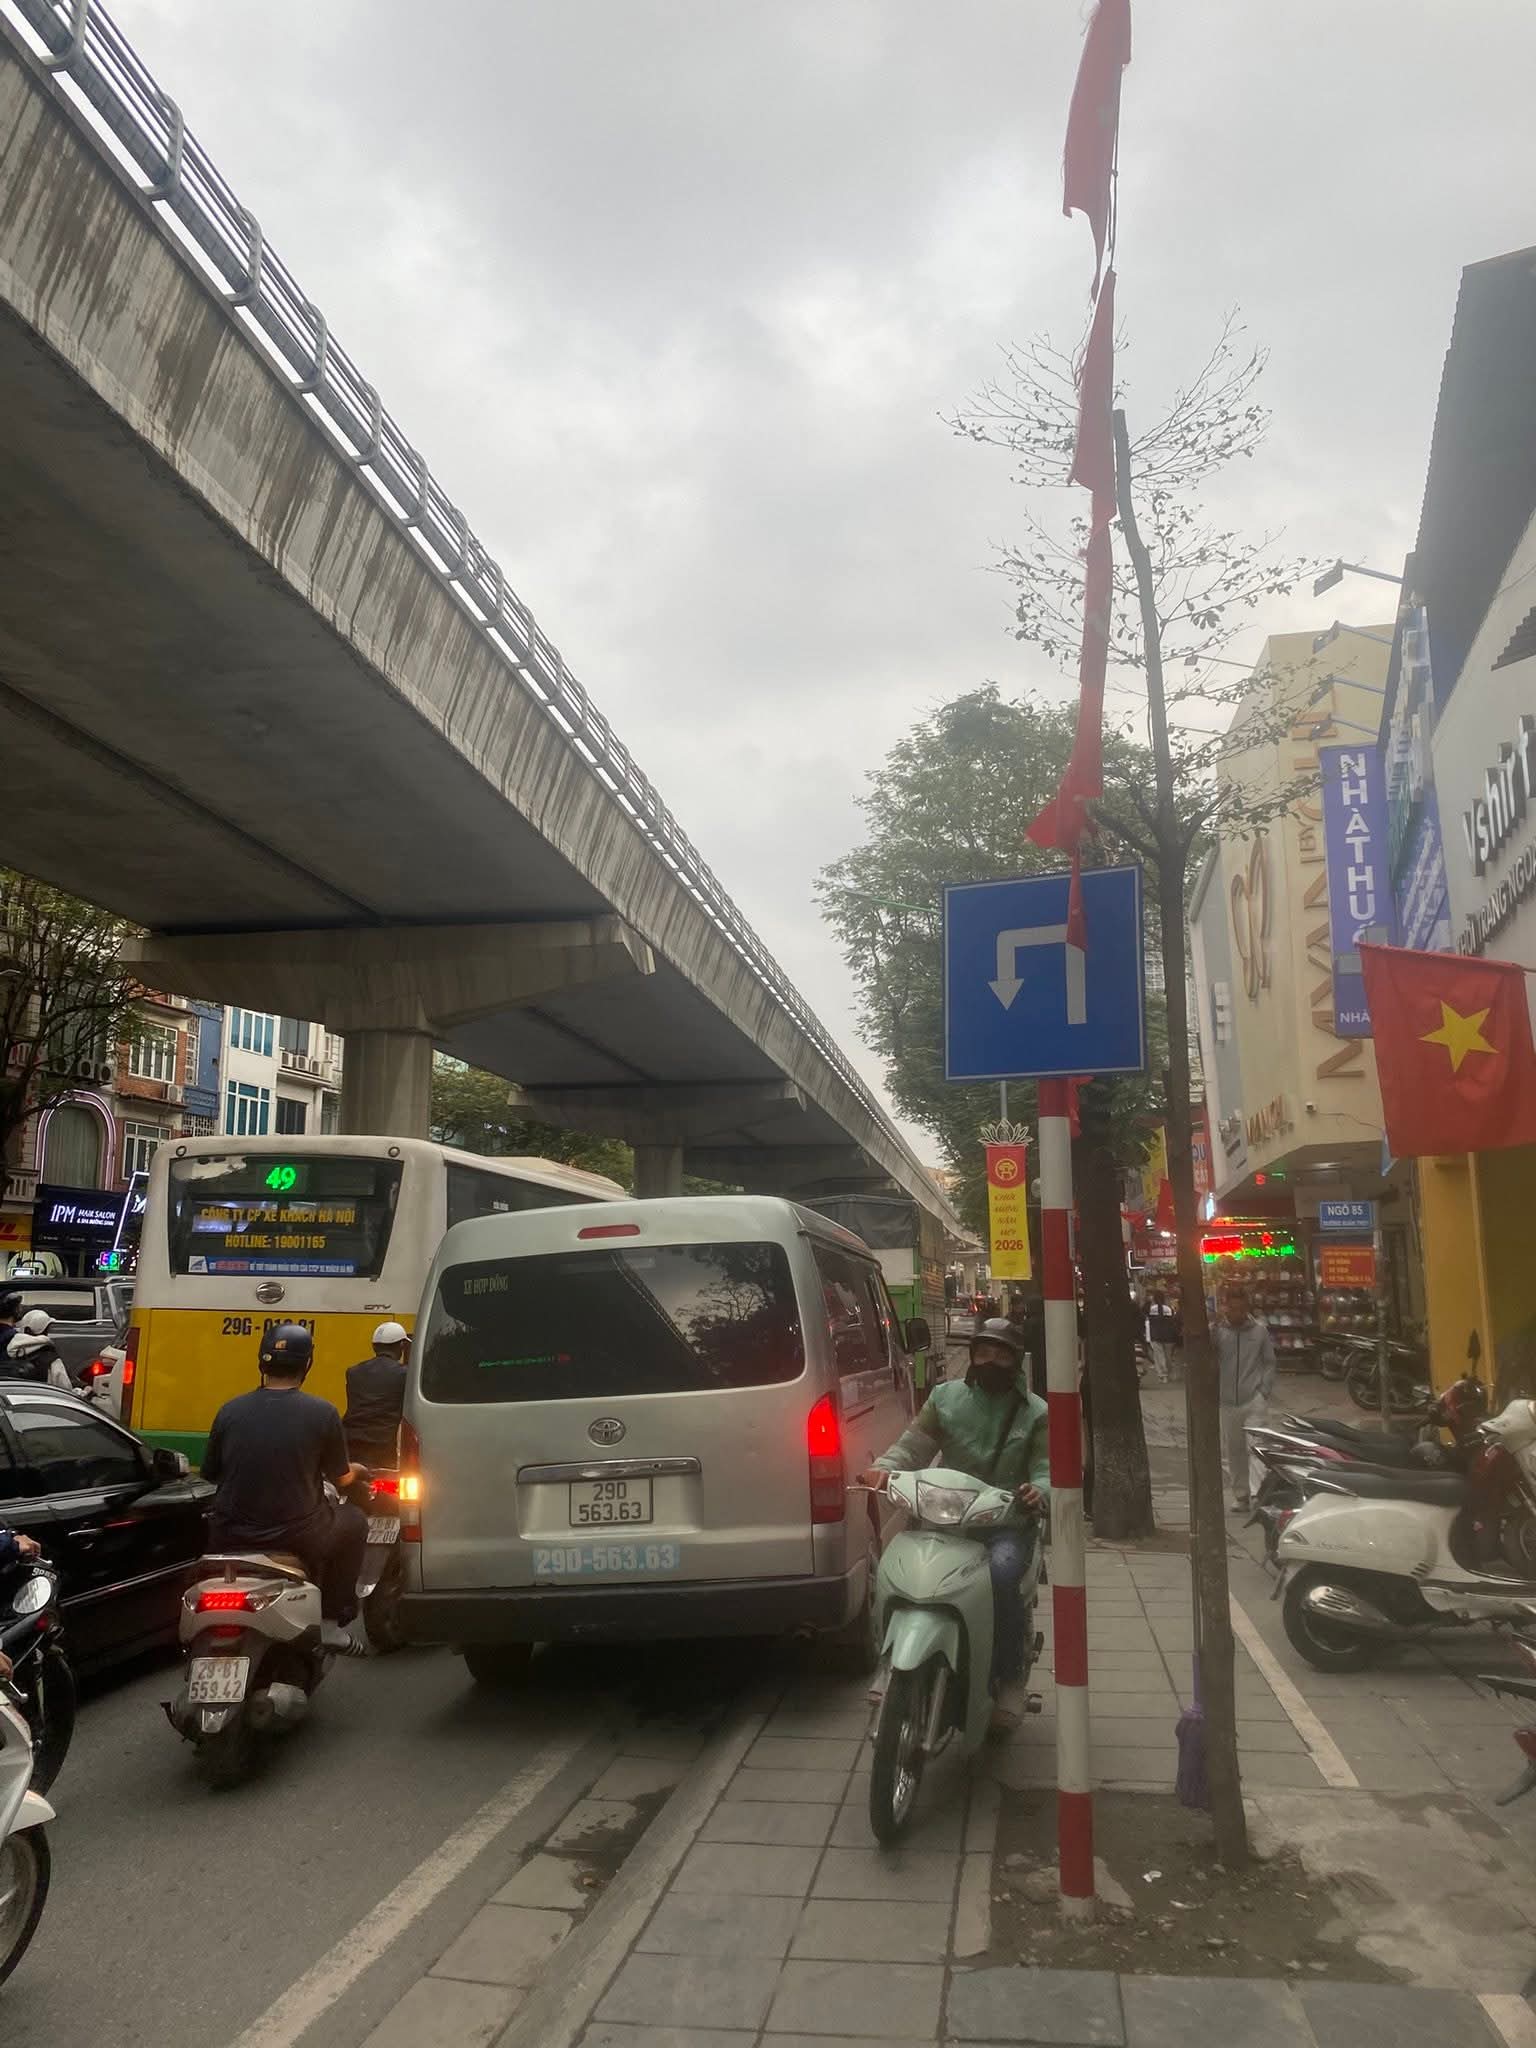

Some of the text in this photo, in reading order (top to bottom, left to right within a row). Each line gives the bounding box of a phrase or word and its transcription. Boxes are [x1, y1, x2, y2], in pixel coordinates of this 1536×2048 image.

[265, 1166, 297, 1190] 49
[95, 1210, 116, 1220] SALON
[201, 1207, 229, 1222] CÔNG
[233, 1208, 244, 1222] TY
[247, 1209, 260, 1222] CP
[263, 1209, 277, 1222] XE
[225, 1234, 327, 1249] HOTLINE: 19001165
[995, 1240, 1024, 1251] 2026
[101, 1253, 118, 1266] 56
[593, 1481, 627, 1501] 29D
[578, 1502, 642, 1522] 563.63
[536, 1544, 677, 1575] 29D-563.63
